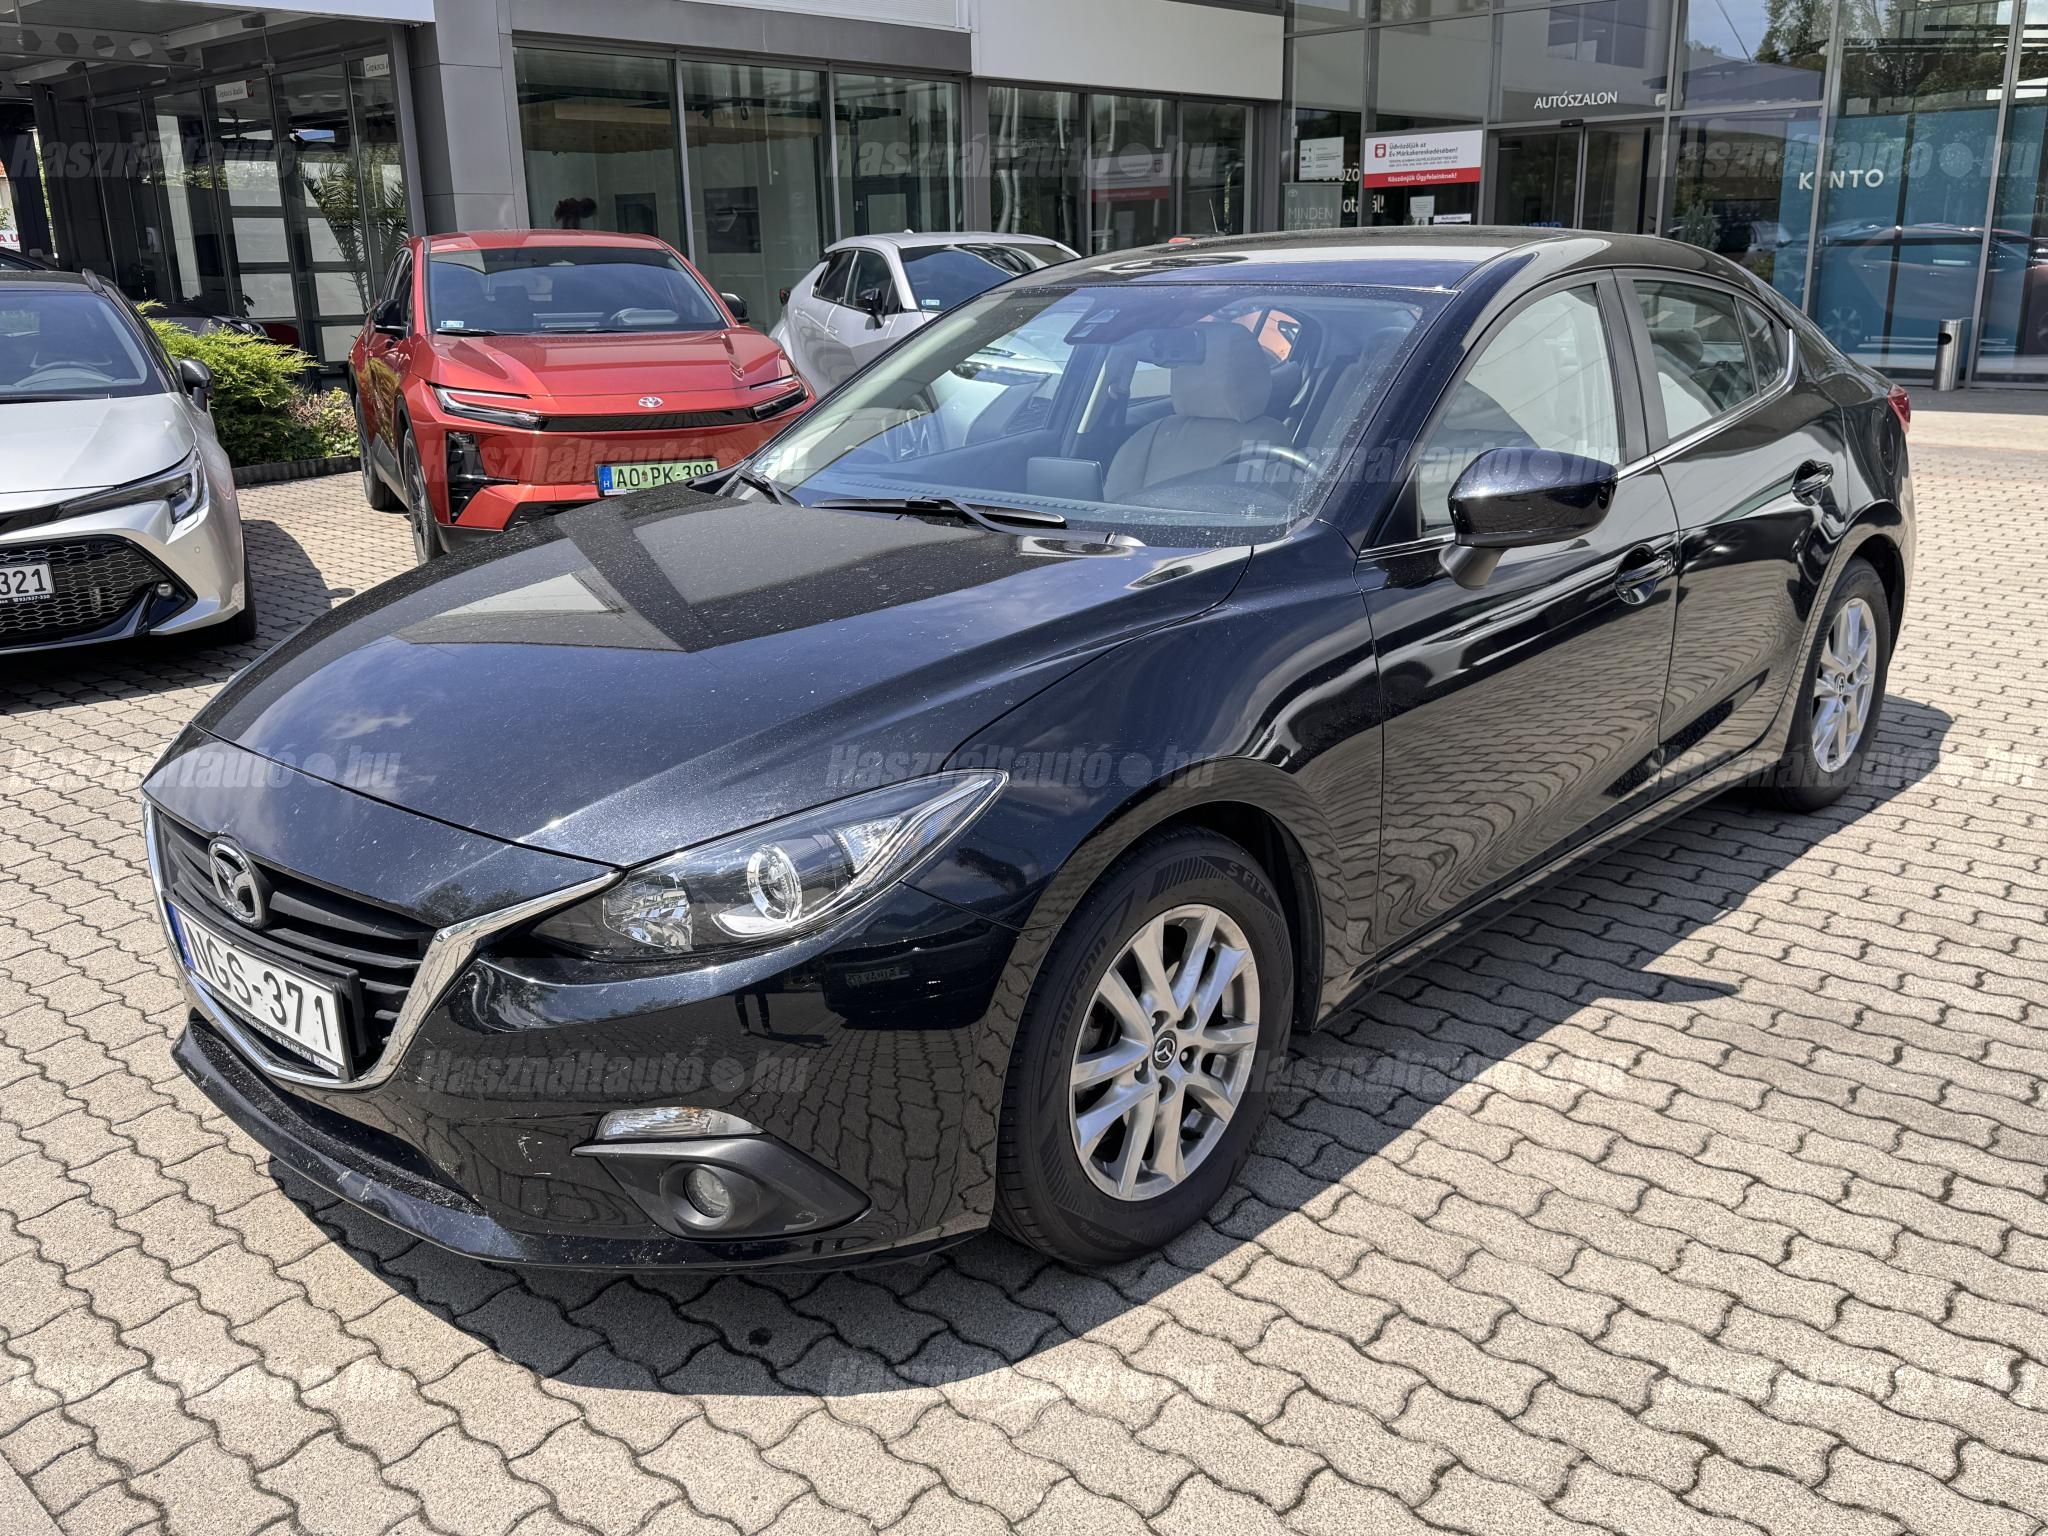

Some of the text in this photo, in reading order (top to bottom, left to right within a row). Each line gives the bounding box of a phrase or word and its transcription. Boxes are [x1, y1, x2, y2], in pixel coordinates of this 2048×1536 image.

[1534, 91, 1618, 109] AUTÓSZALON
[1798, 169, 1884, 190] KNTO
[1288, 207, 1333, 220] MINDEN
[185, 921, 332, 1052] NGS-371
